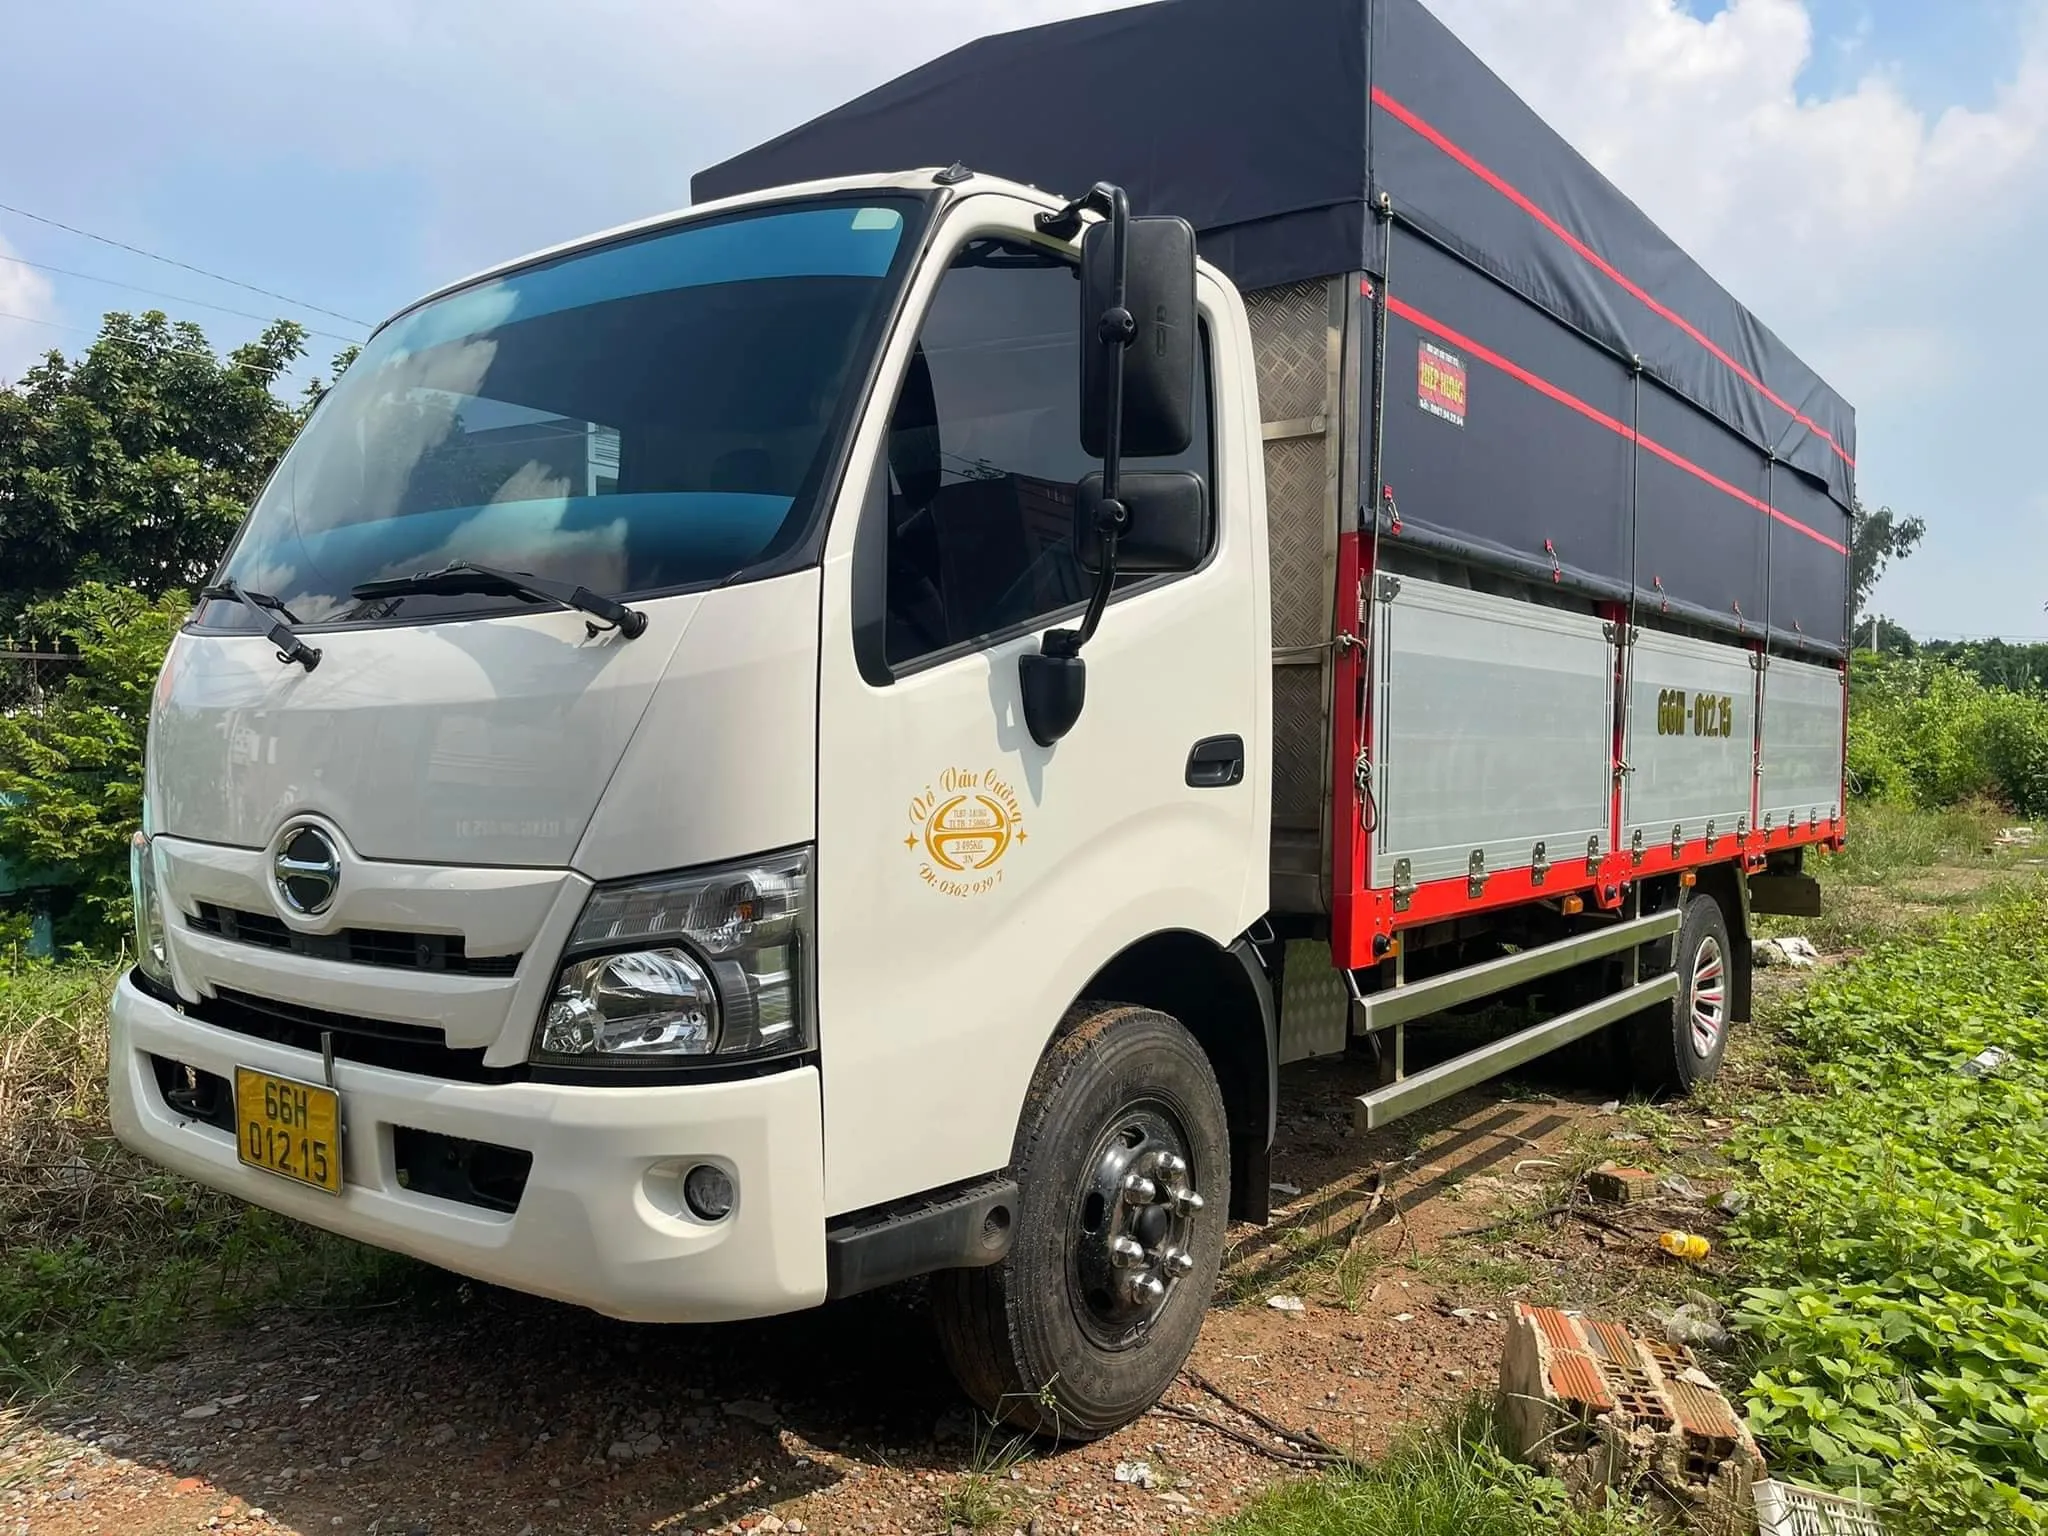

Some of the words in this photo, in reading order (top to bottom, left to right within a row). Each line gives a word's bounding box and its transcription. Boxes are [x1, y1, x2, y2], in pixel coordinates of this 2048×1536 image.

[940, 880, 969, 897] 0362
[264, 1081, 307, 1130] 66H
[249, 1121, 327, 1183] 012.15
